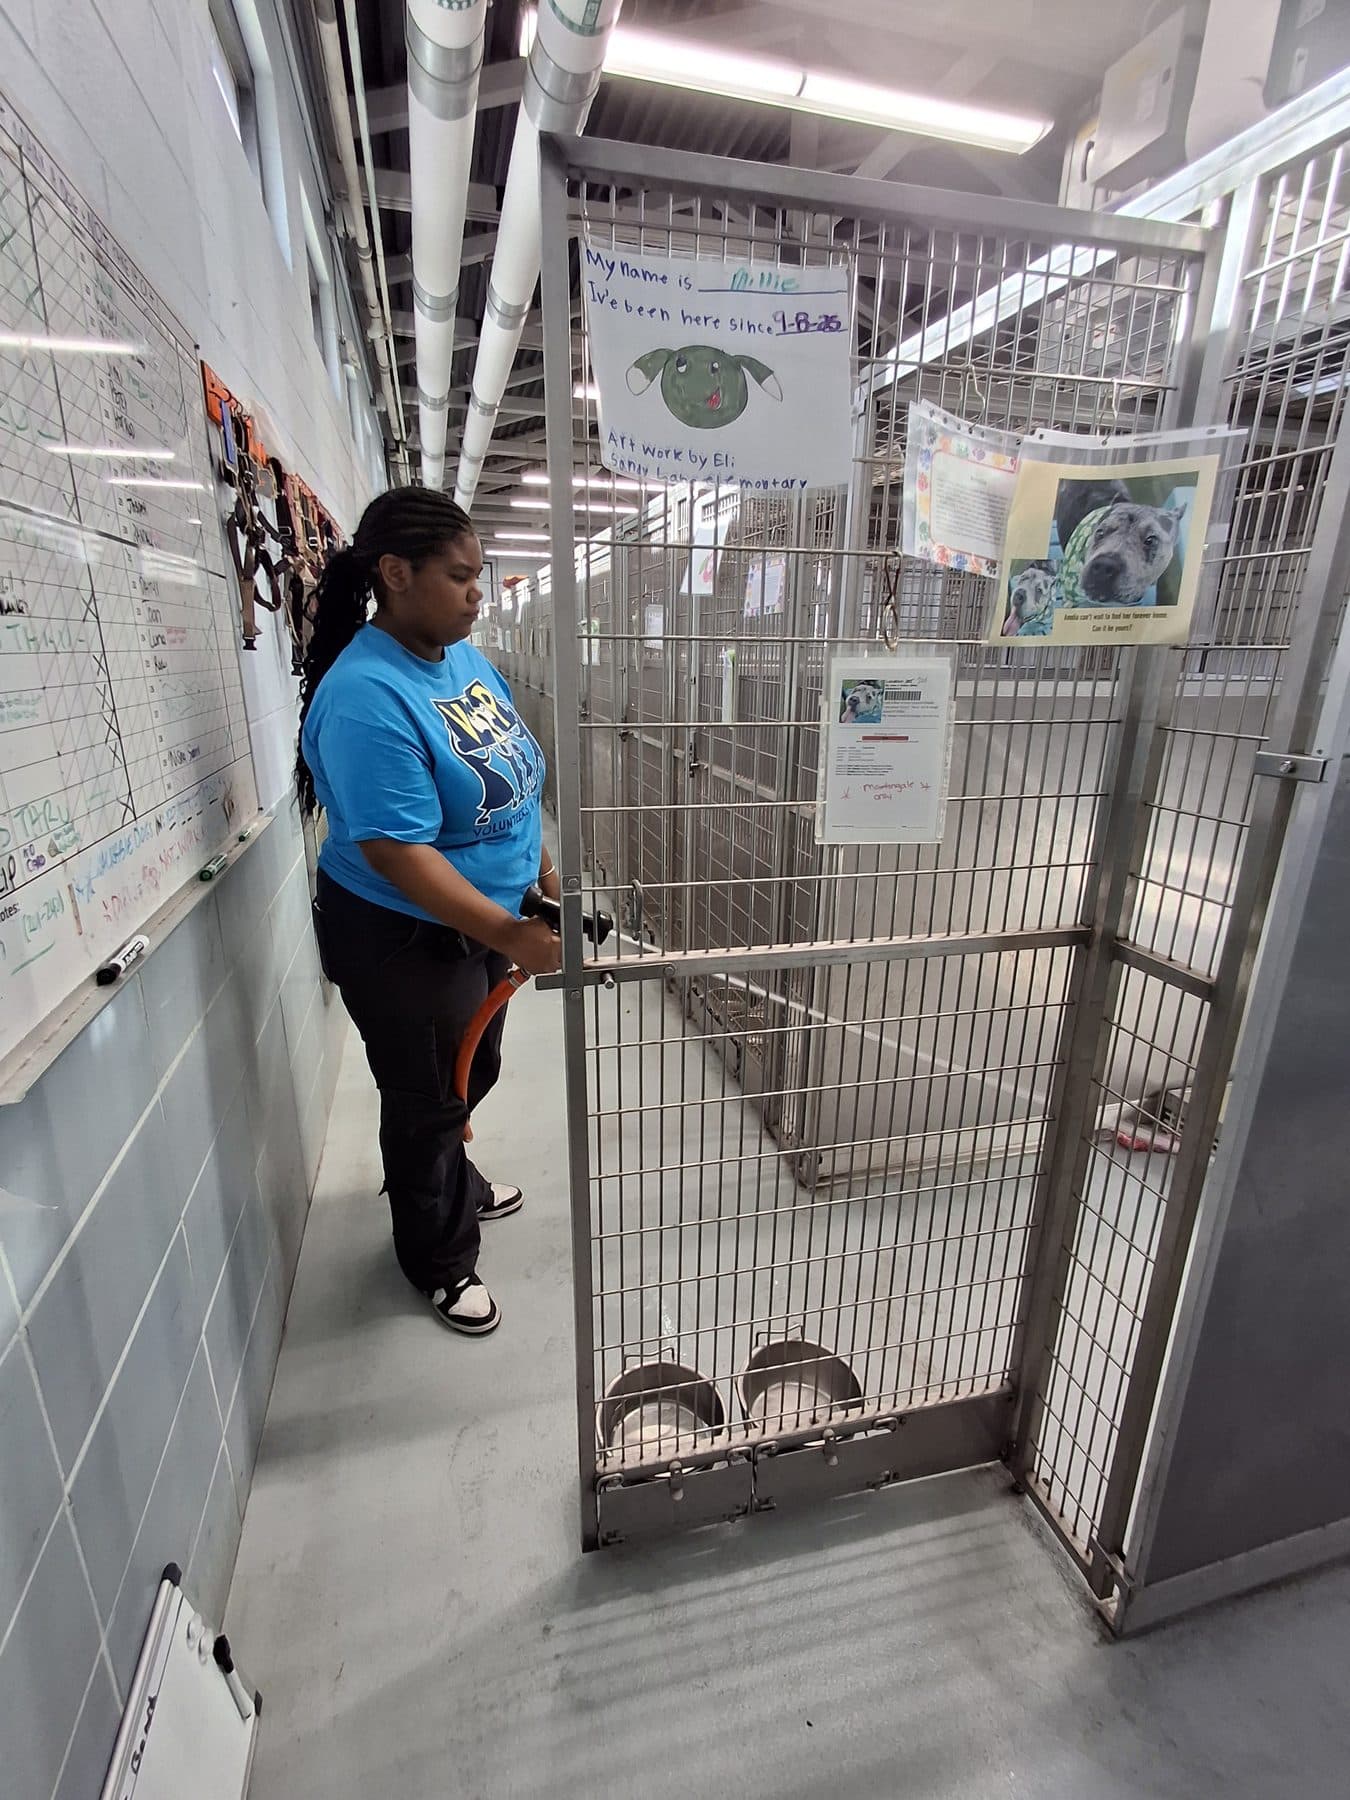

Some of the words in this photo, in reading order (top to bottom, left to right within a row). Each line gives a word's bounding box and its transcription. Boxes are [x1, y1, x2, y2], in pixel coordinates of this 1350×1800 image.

[585, 249, 615, 281] My
[620, 260, 668, 285] name
[678, 275, 692, 290] is
[624, 299, 670, 321] been
[681, 309, 720, 330] here
[730, 317, 773, 335] since
[689, 450, 708, 470] by
[714, 453, 735, 468] Eli
[1115, 624, 1133, 632] yours?
[473, 806, 530, 837] VOLUNTEERS
